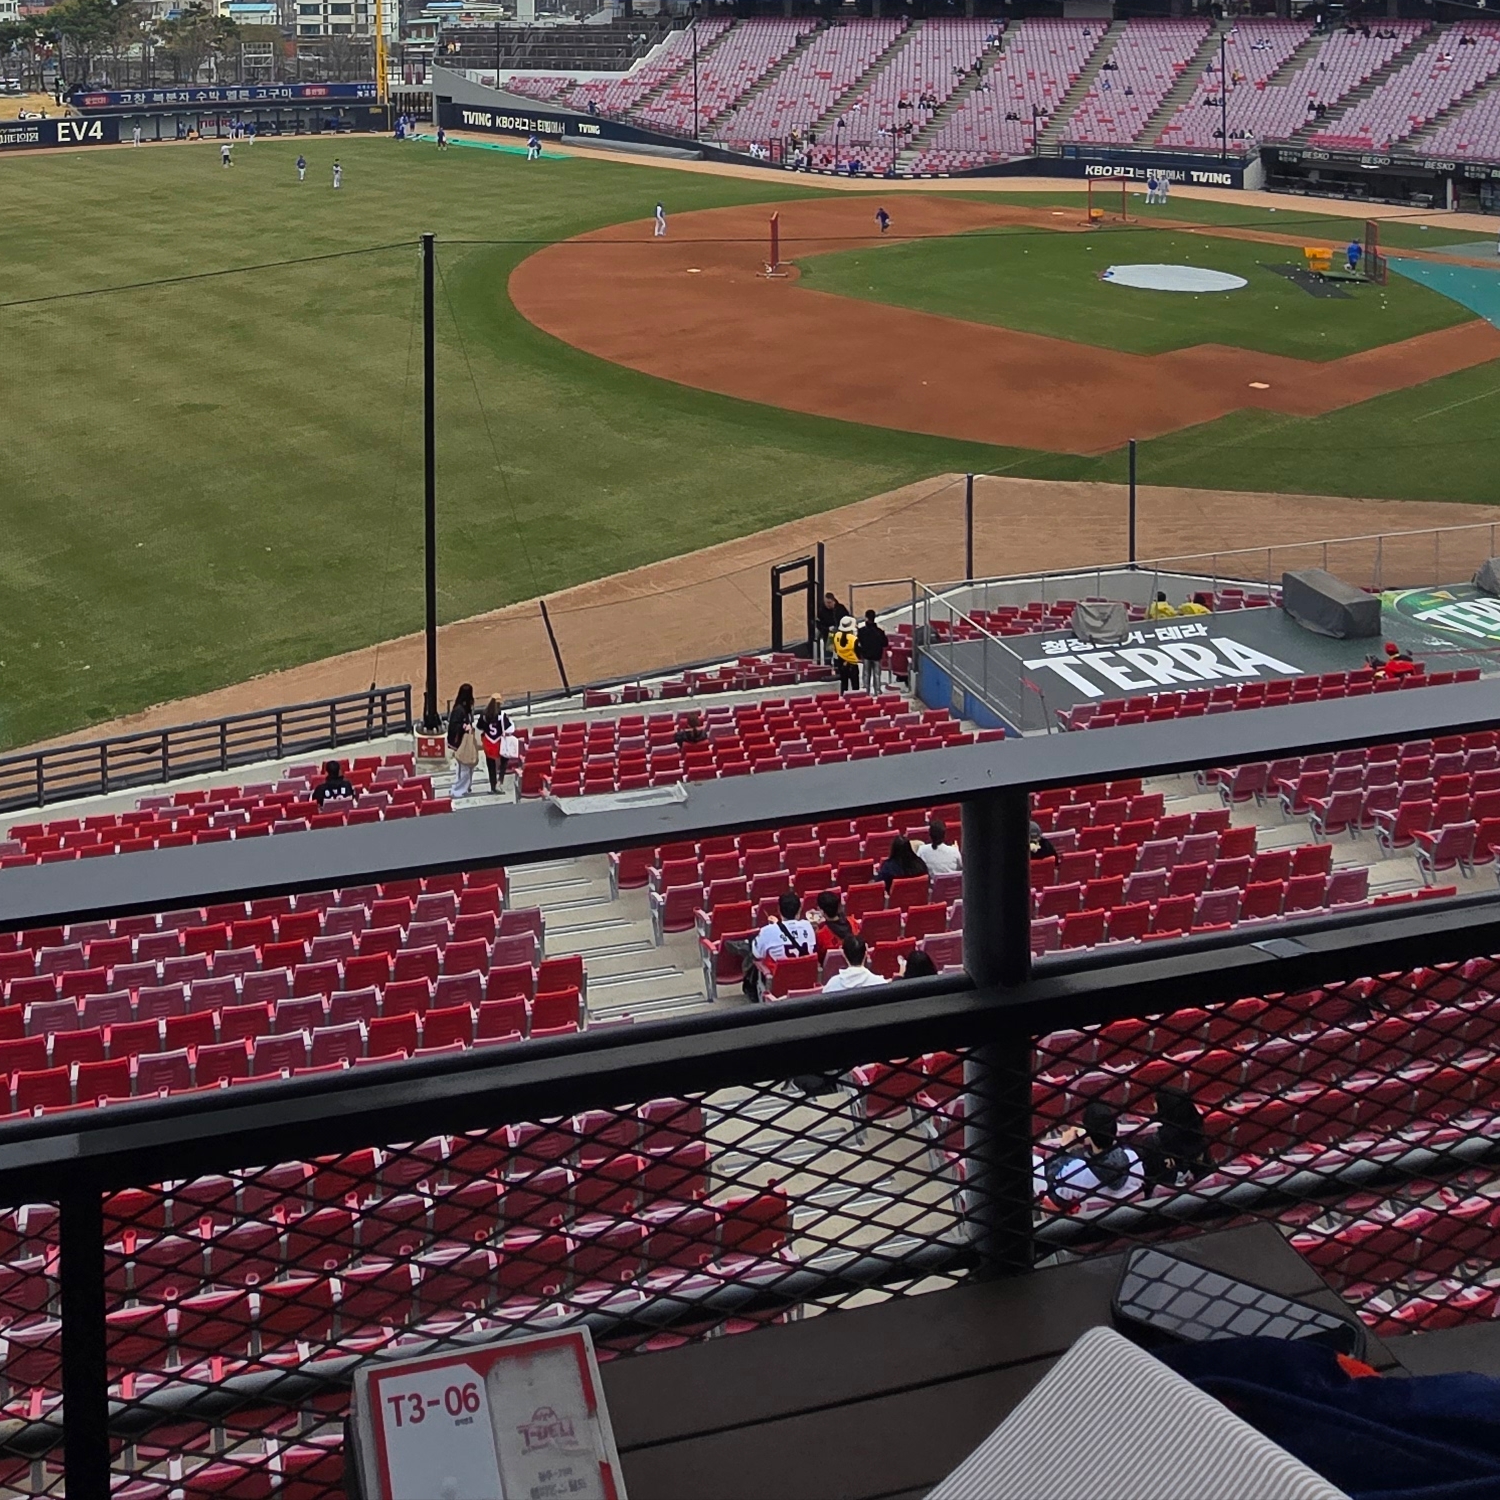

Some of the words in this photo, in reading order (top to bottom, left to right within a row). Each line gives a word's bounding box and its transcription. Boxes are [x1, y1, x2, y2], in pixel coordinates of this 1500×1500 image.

[120, 93, 146, 105] 고창
[196, 91, 219, 102] 수박
[256, 88, 293, 99] 고구마
[462, 111, 492, 127] TVING
[57, 120, 104, 143] EV4
[578, 123, 601, 135] TVING
[1424, 160, 1456, 171] BESKO
[1190, 171, 1232, 185] TVING
[1023, 637, 1305, 698] TERRA
[388, 1382, 481, 1428] T3-06
